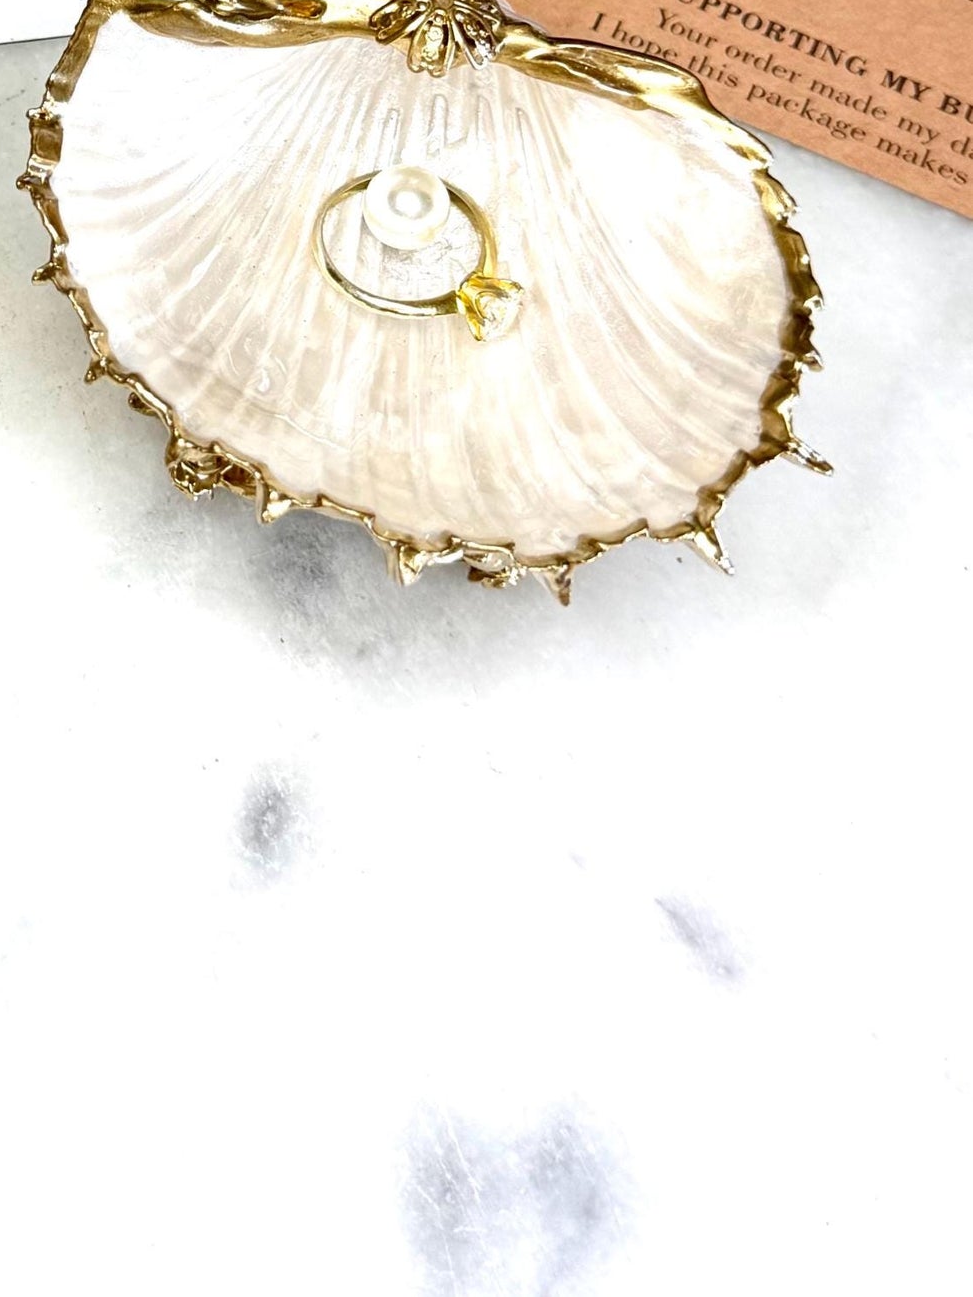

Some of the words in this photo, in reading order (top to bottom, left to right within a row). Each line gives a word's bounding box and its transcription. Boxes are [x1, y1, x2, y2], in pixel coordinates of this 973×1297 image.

[589, 11, 607, 33] I
[611, 20, 678, 60] hope
[687, 54, 739, 89] this
[746, 83, 868, 140] package
[876, 137, 969, 186] makes
[657, 7, 719, 49] Your
[724, 43, 802, 84] order
[810, 79, 888, 121] made
[896, 116, 941, 145] my
[880, 68, 932, 103] MY
